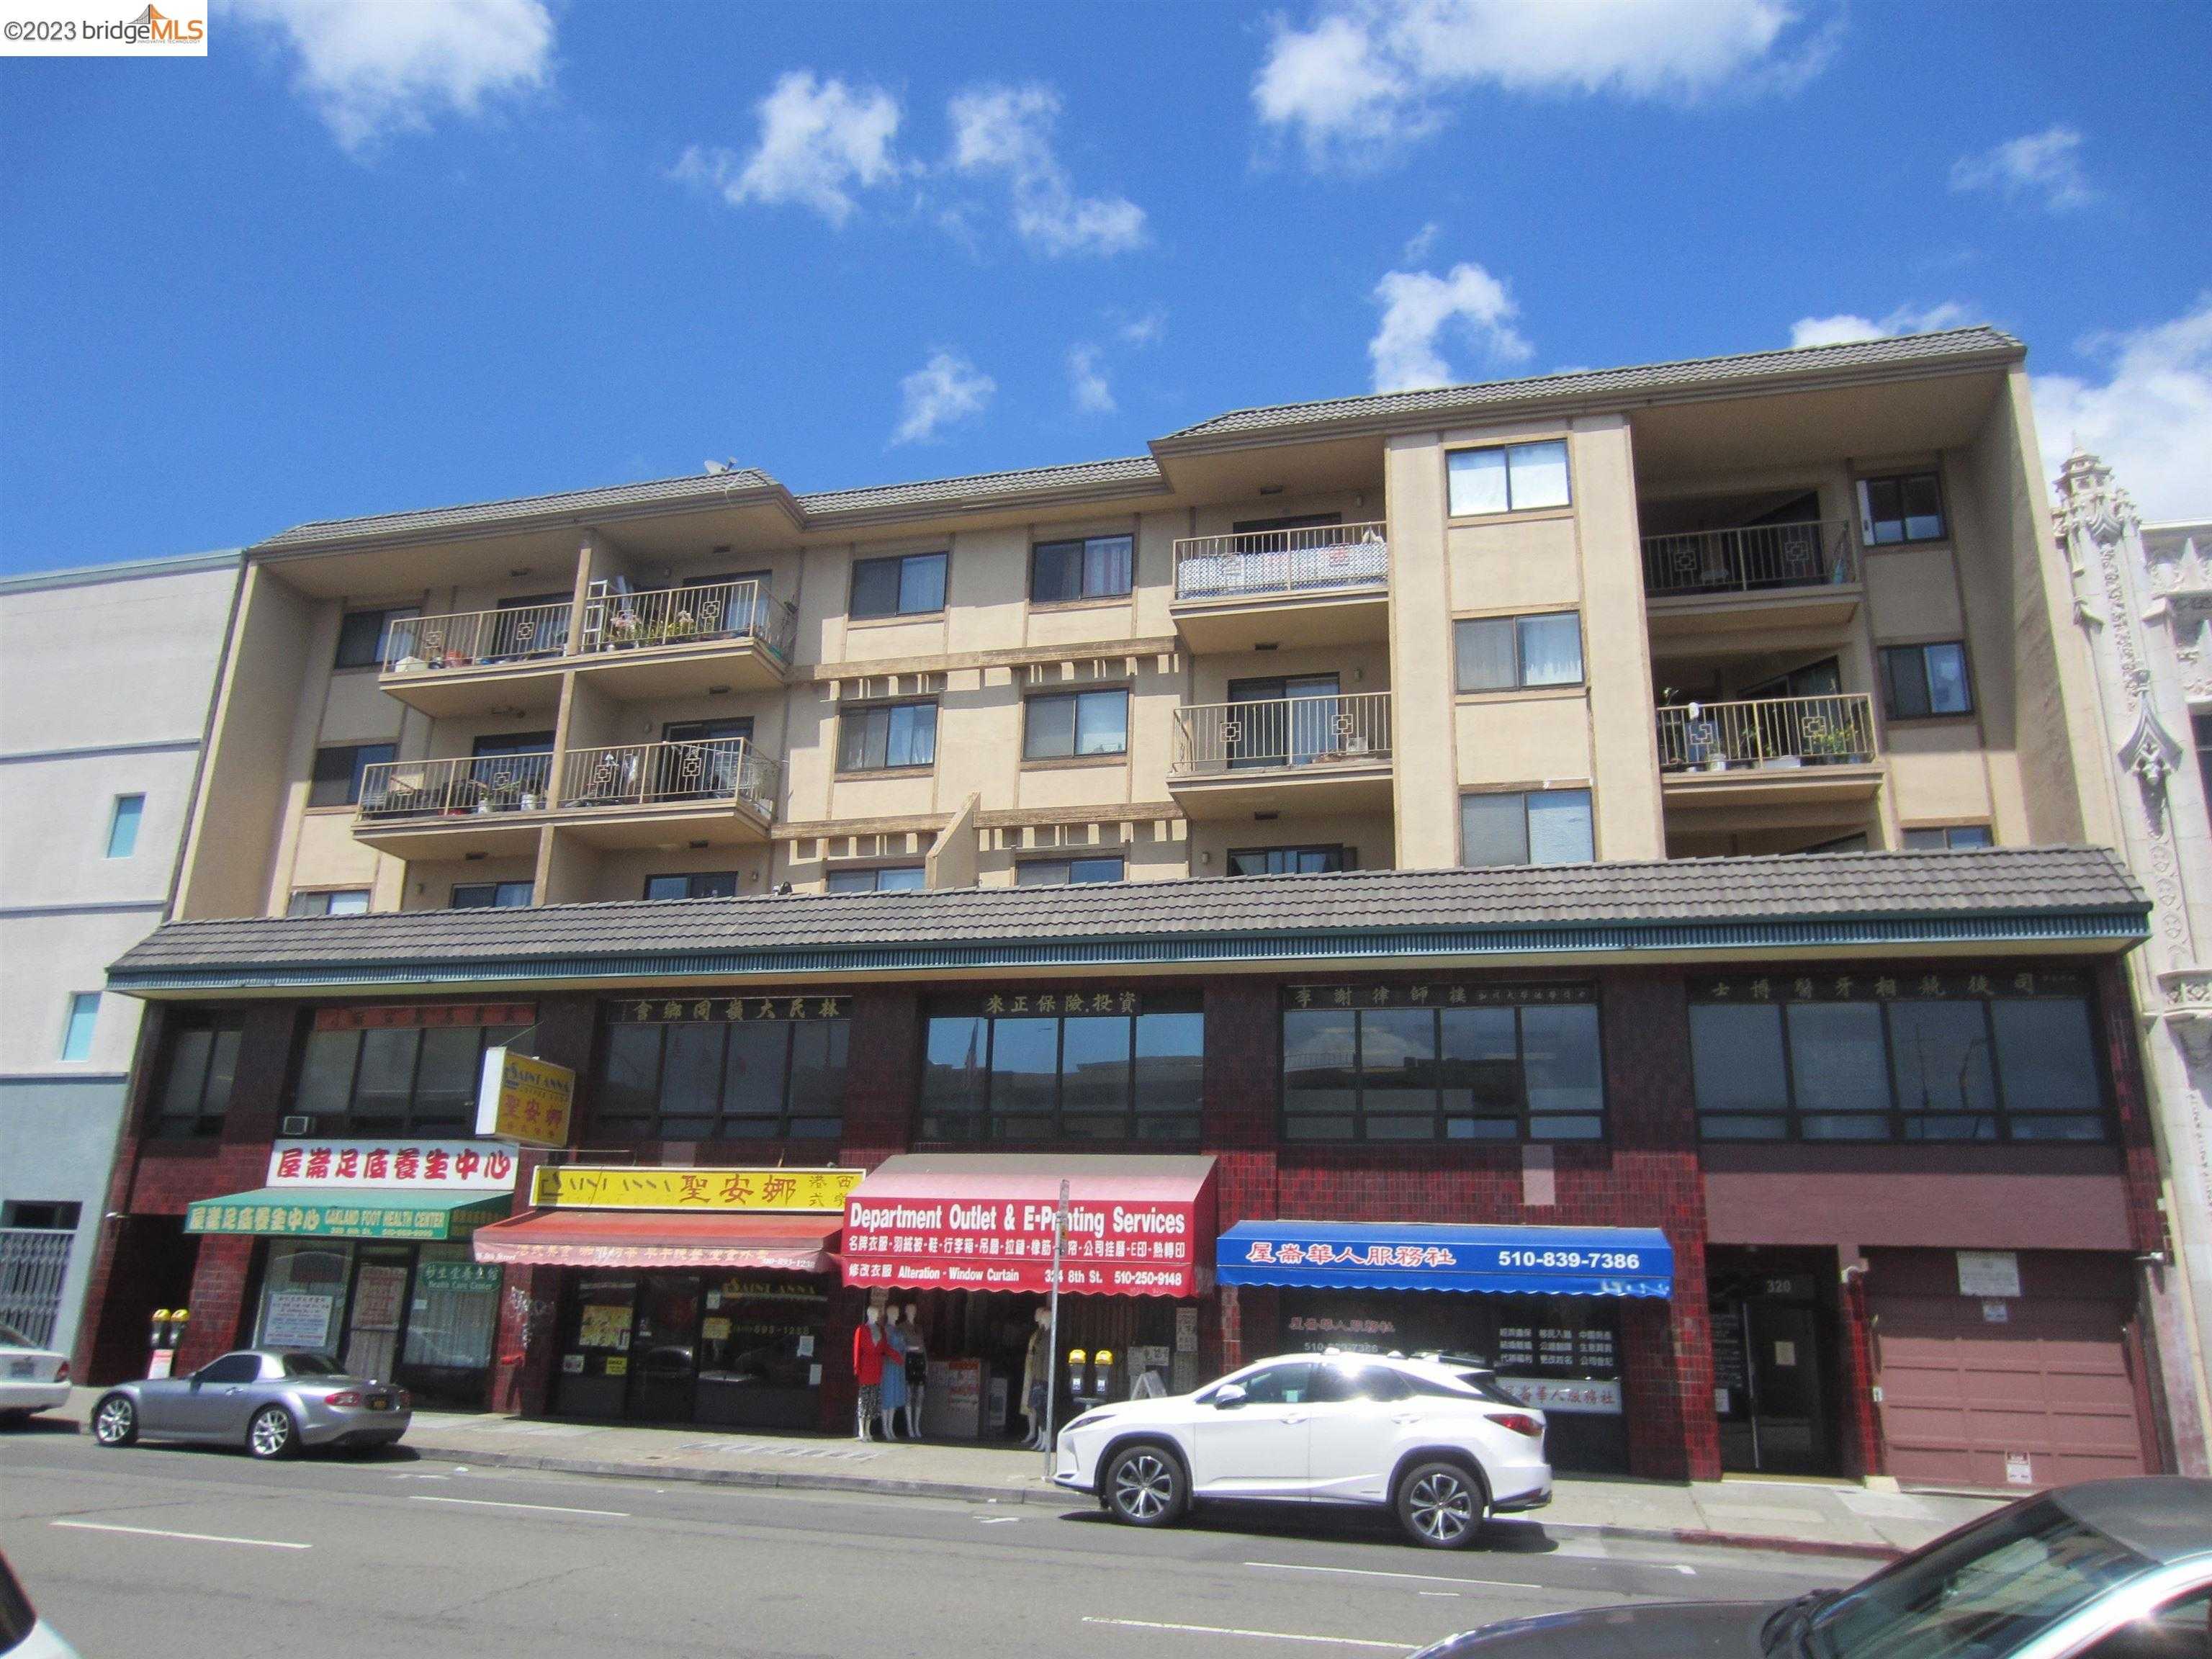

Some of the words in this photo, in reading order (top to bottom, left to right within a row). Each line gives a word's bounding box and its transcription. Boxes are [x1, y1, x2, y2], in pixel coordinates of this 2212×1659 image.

[678, 1173, 796, 1205] 聖安娜
[849, 1202, 943, 1232] Department
[949, 1204, 997, 1231] Outlet
[1003, 1204, 1015, 1231] &
[1112, 1206, 1186, 1235] Services
[1498, 1250, 1640, 1270] 510-839-7386
[898, 1265, 940, 1280] Alteration
[949, 1267, 983, 1282] Window
[986, 1268, 1019, 1282] Curtain
[1068, 1272, 1085, 1284] 8th
[1089, 1272, 1103, 1284] St.
[1114, 1272, 1182, 1286] 510-250-9148
